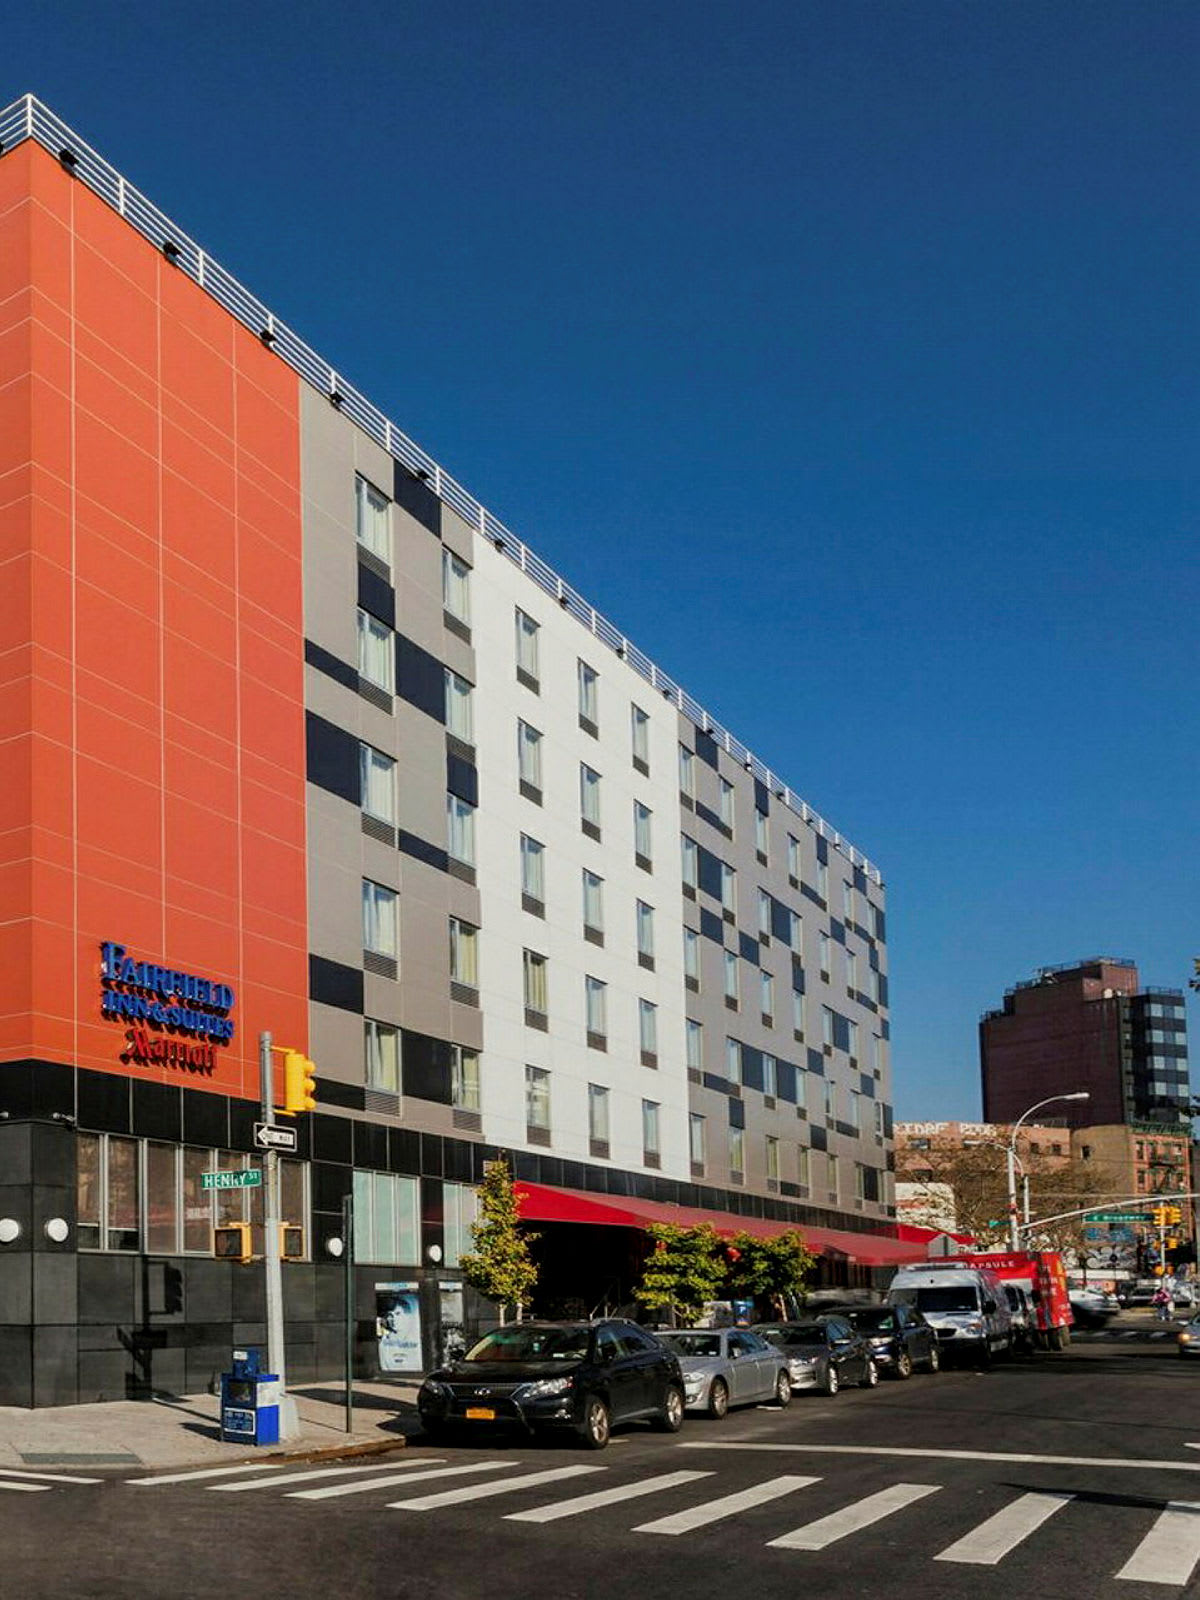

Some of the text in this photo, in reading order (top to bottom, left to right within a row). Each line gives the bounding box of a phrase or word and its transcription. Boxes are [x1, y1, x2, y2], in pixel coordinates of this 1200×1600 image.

[100, 941, 235, 1009] FAIRFIELD
[102, 989, 149, 1019] INN
[170, 1006, 235, 1039] SUITES
[205, 1173, 245, 1187] HENRY
[963, 1260, 1016, 1269] APSULE
